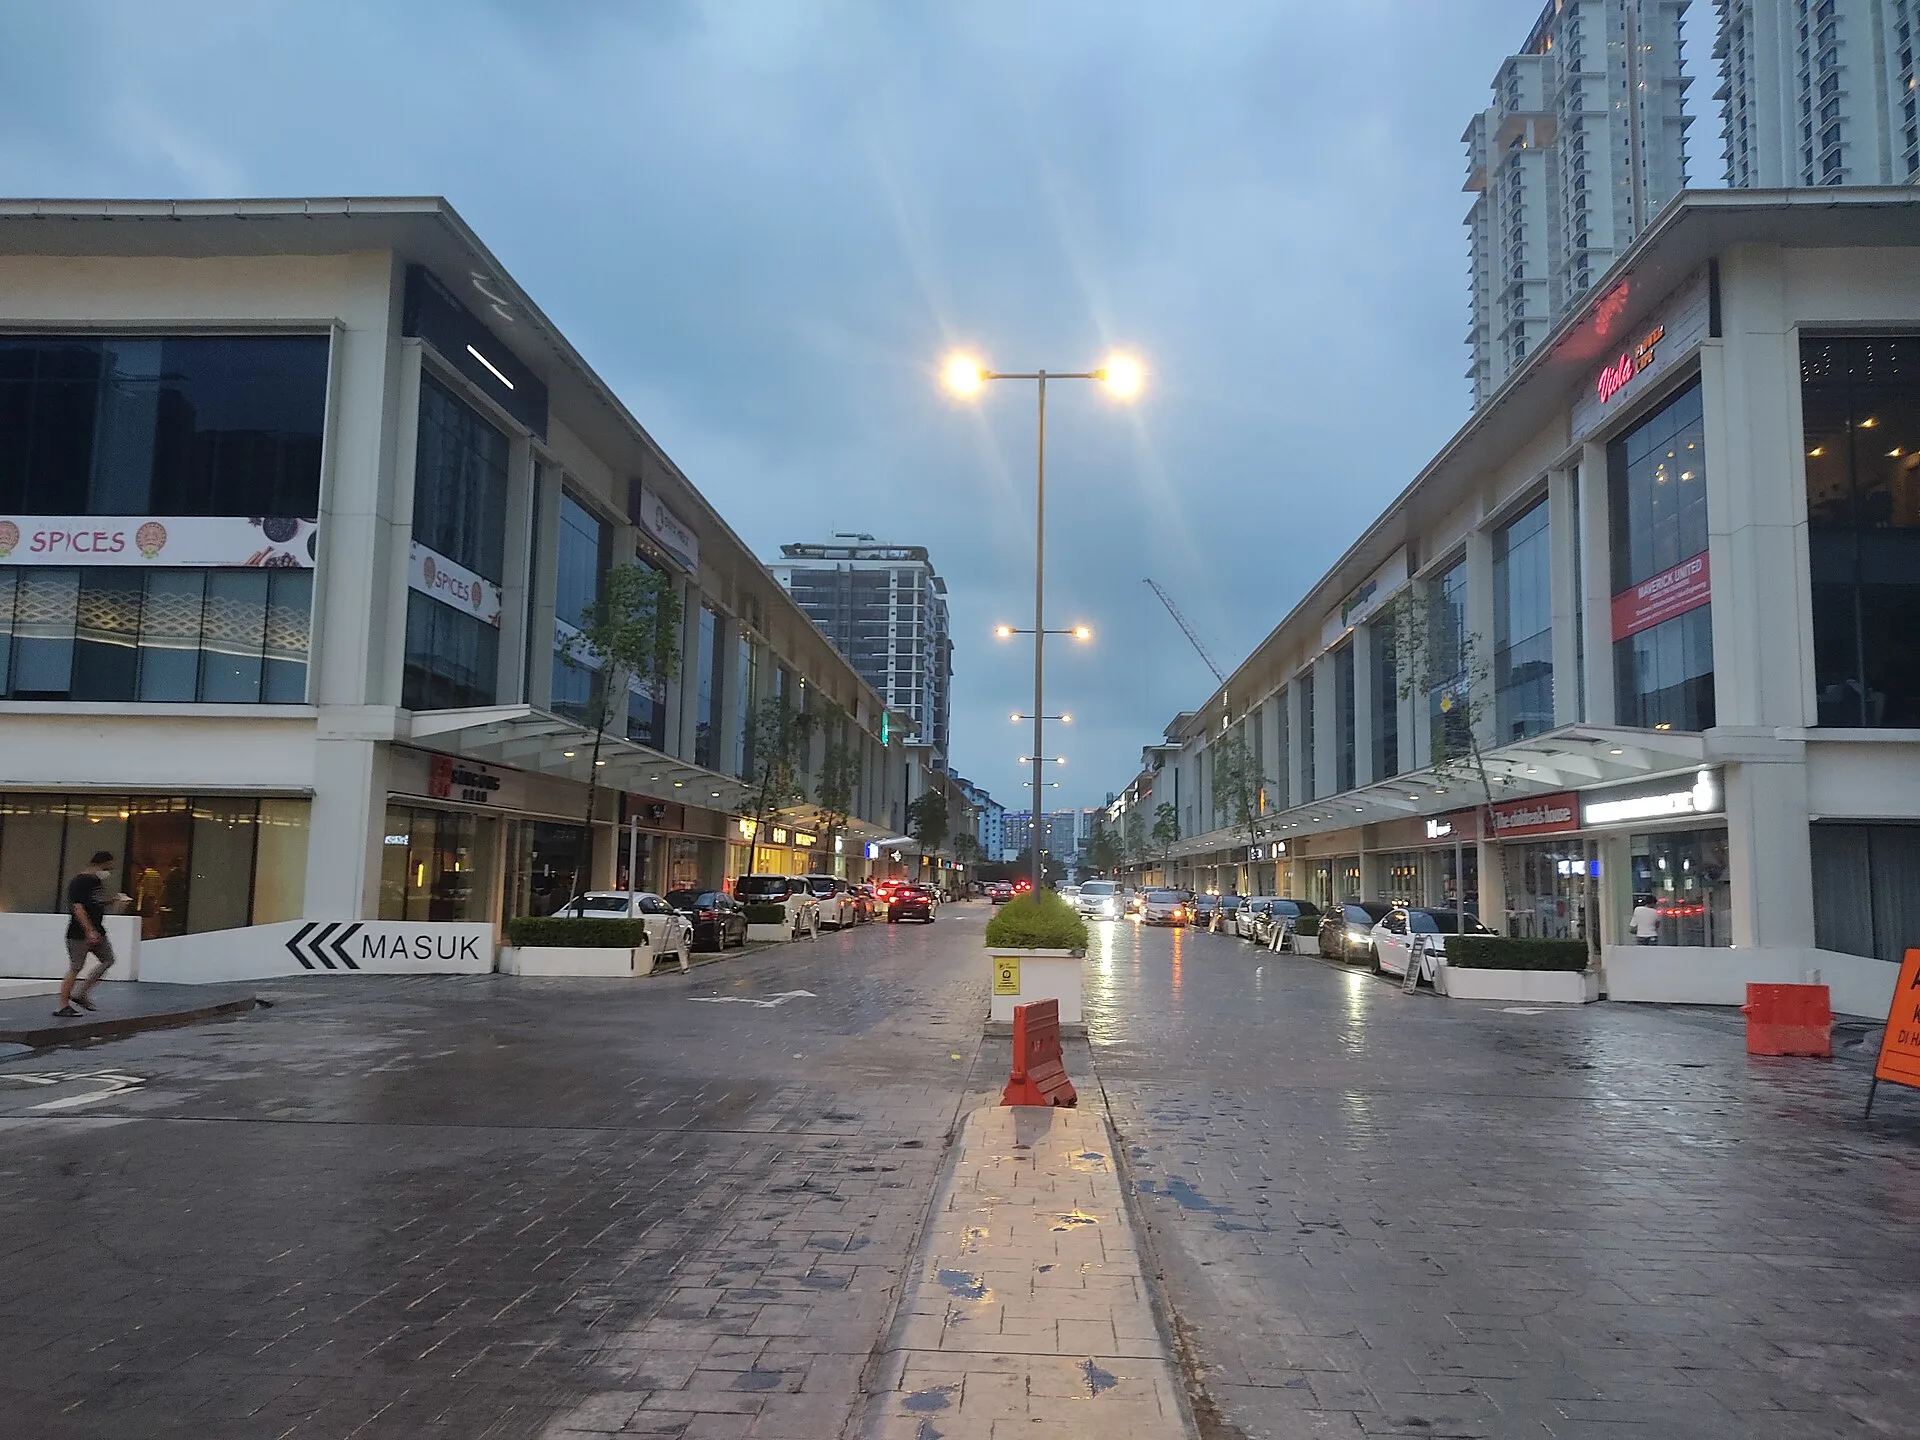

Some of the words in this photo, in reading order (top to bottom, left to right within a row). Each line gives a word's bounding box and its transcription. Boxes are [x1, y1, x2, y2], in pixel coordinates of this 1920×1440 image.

[1598, 353, 1633, 403] Viola
[30, 530, 125, 553] SPICES
[435, 571, 469, 602] SPICES
[1638, 571, 1675, 600] MAVERICK
[1674, 558, 1703, 583] UNITED
[361, 934, 481, 960] MASUK
